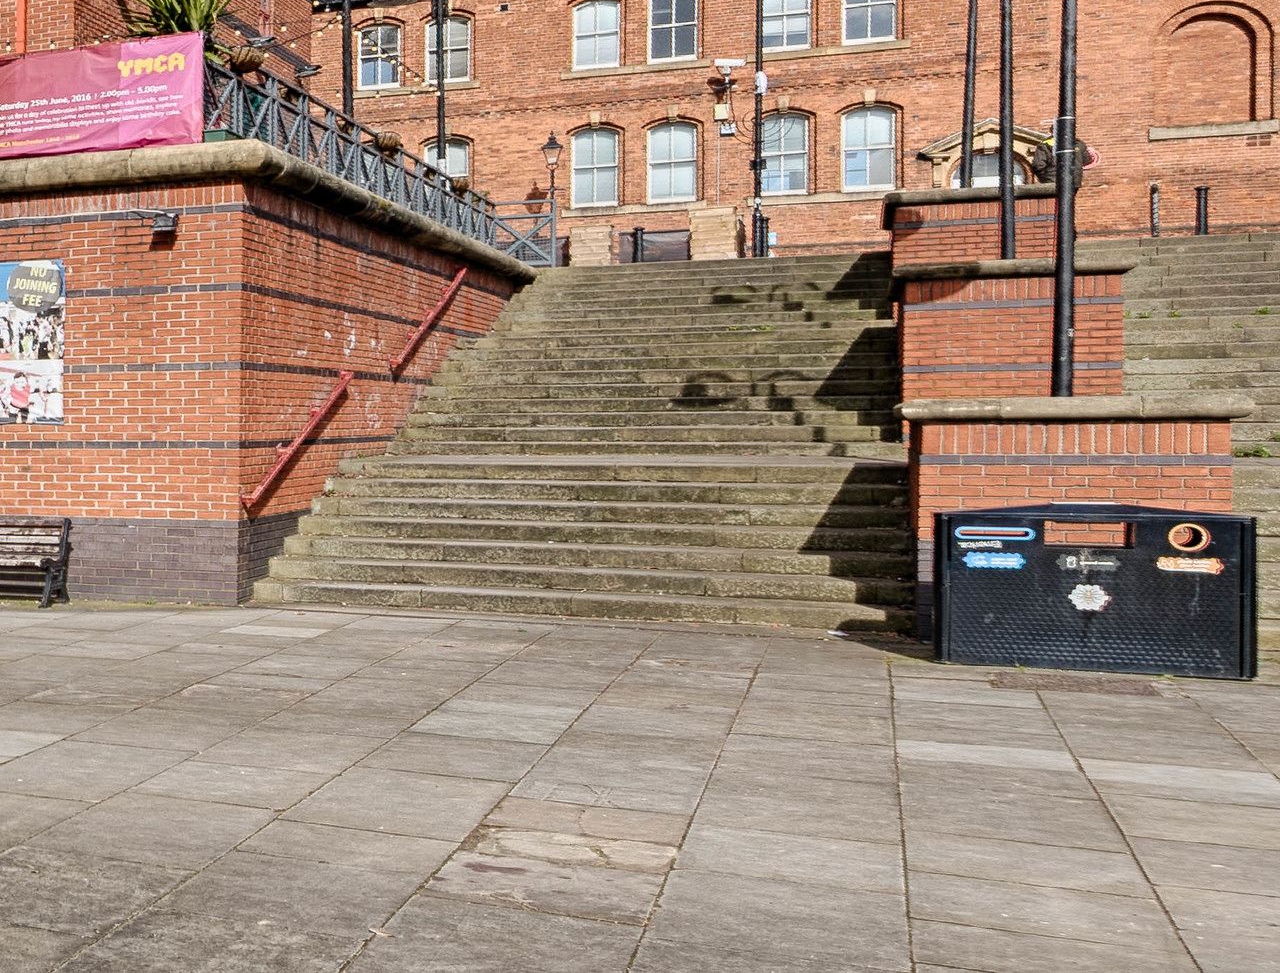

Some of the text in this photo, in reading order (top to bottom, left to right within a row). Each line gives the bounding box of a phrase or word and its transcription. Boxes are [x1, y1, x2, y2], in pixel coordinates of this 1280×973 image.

[117, 52, 186, 78] YMCA
[71, 93, 92, 103] 2016
[12, 277, 59, 292] JOINING
[22, 295, 43, 307] FEE
